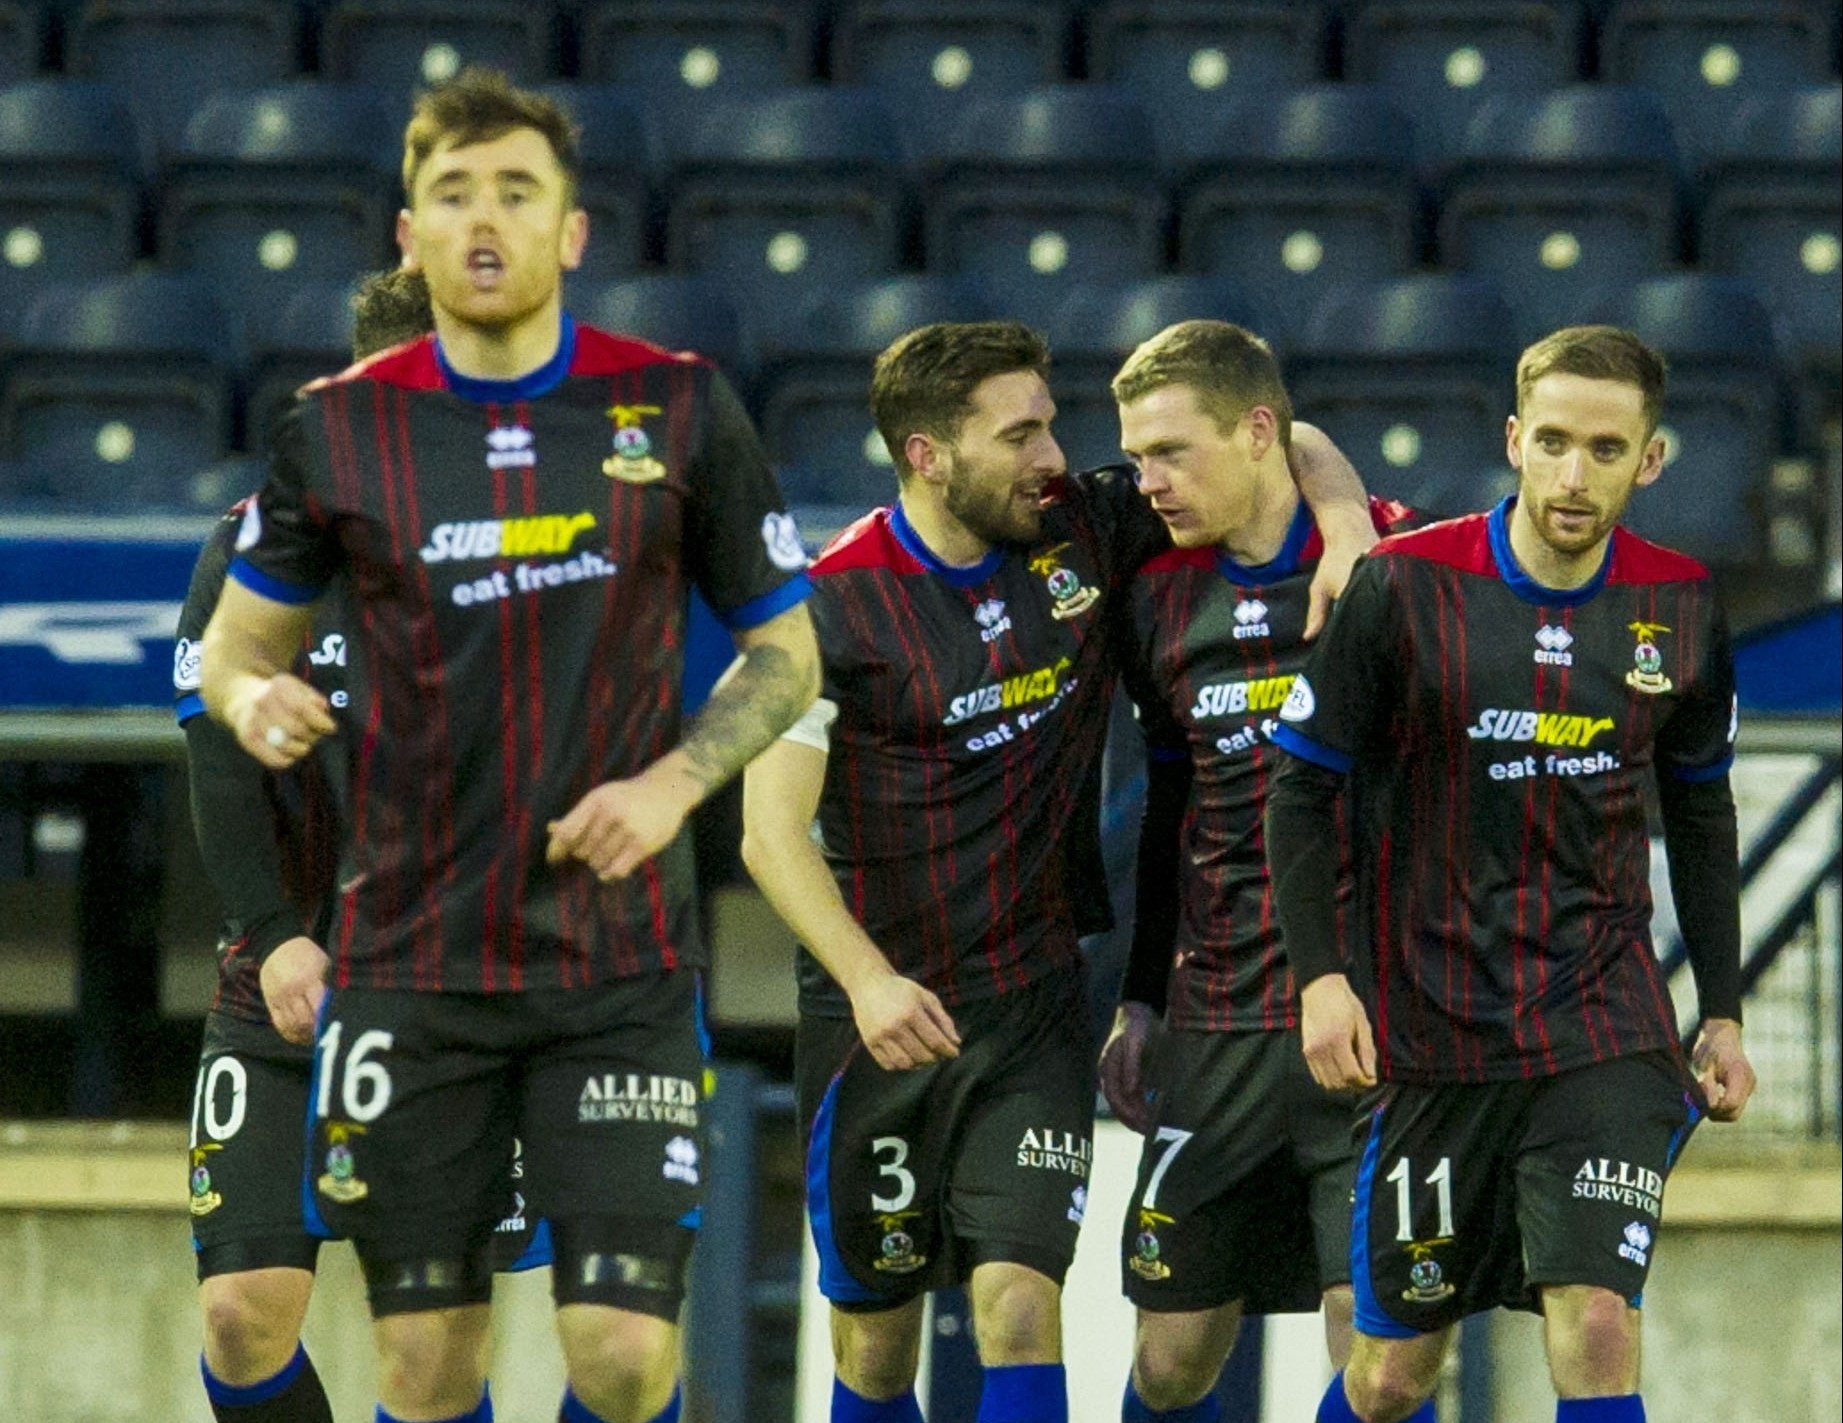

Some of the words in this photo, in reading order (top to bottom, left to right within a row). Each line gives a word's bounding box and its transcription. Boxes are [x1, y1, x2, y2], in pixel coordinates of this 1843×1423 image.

[419, 511, 597, 563] SUBWAY
[452, 571, 510, 606] eat
[942, 656, 1072, 726] SUBWAY
[1191, 675, 1297, 720] SUBWA
[966, 723, 1015, 752] eat
[1216, 725, 1259, 755] eat
[1467, 708, 1615, 748] SUBWAY
[1488, 755, 1537, 780] eat
[316, 1020, 394, 1123] 16
[579, 1073, 698, 1107] ALLIED
[871, 1136, 916, 1213] 3
[1142, 1126, 1194, 1210] 7
[1386, 1156, 1455, 1241] 11
